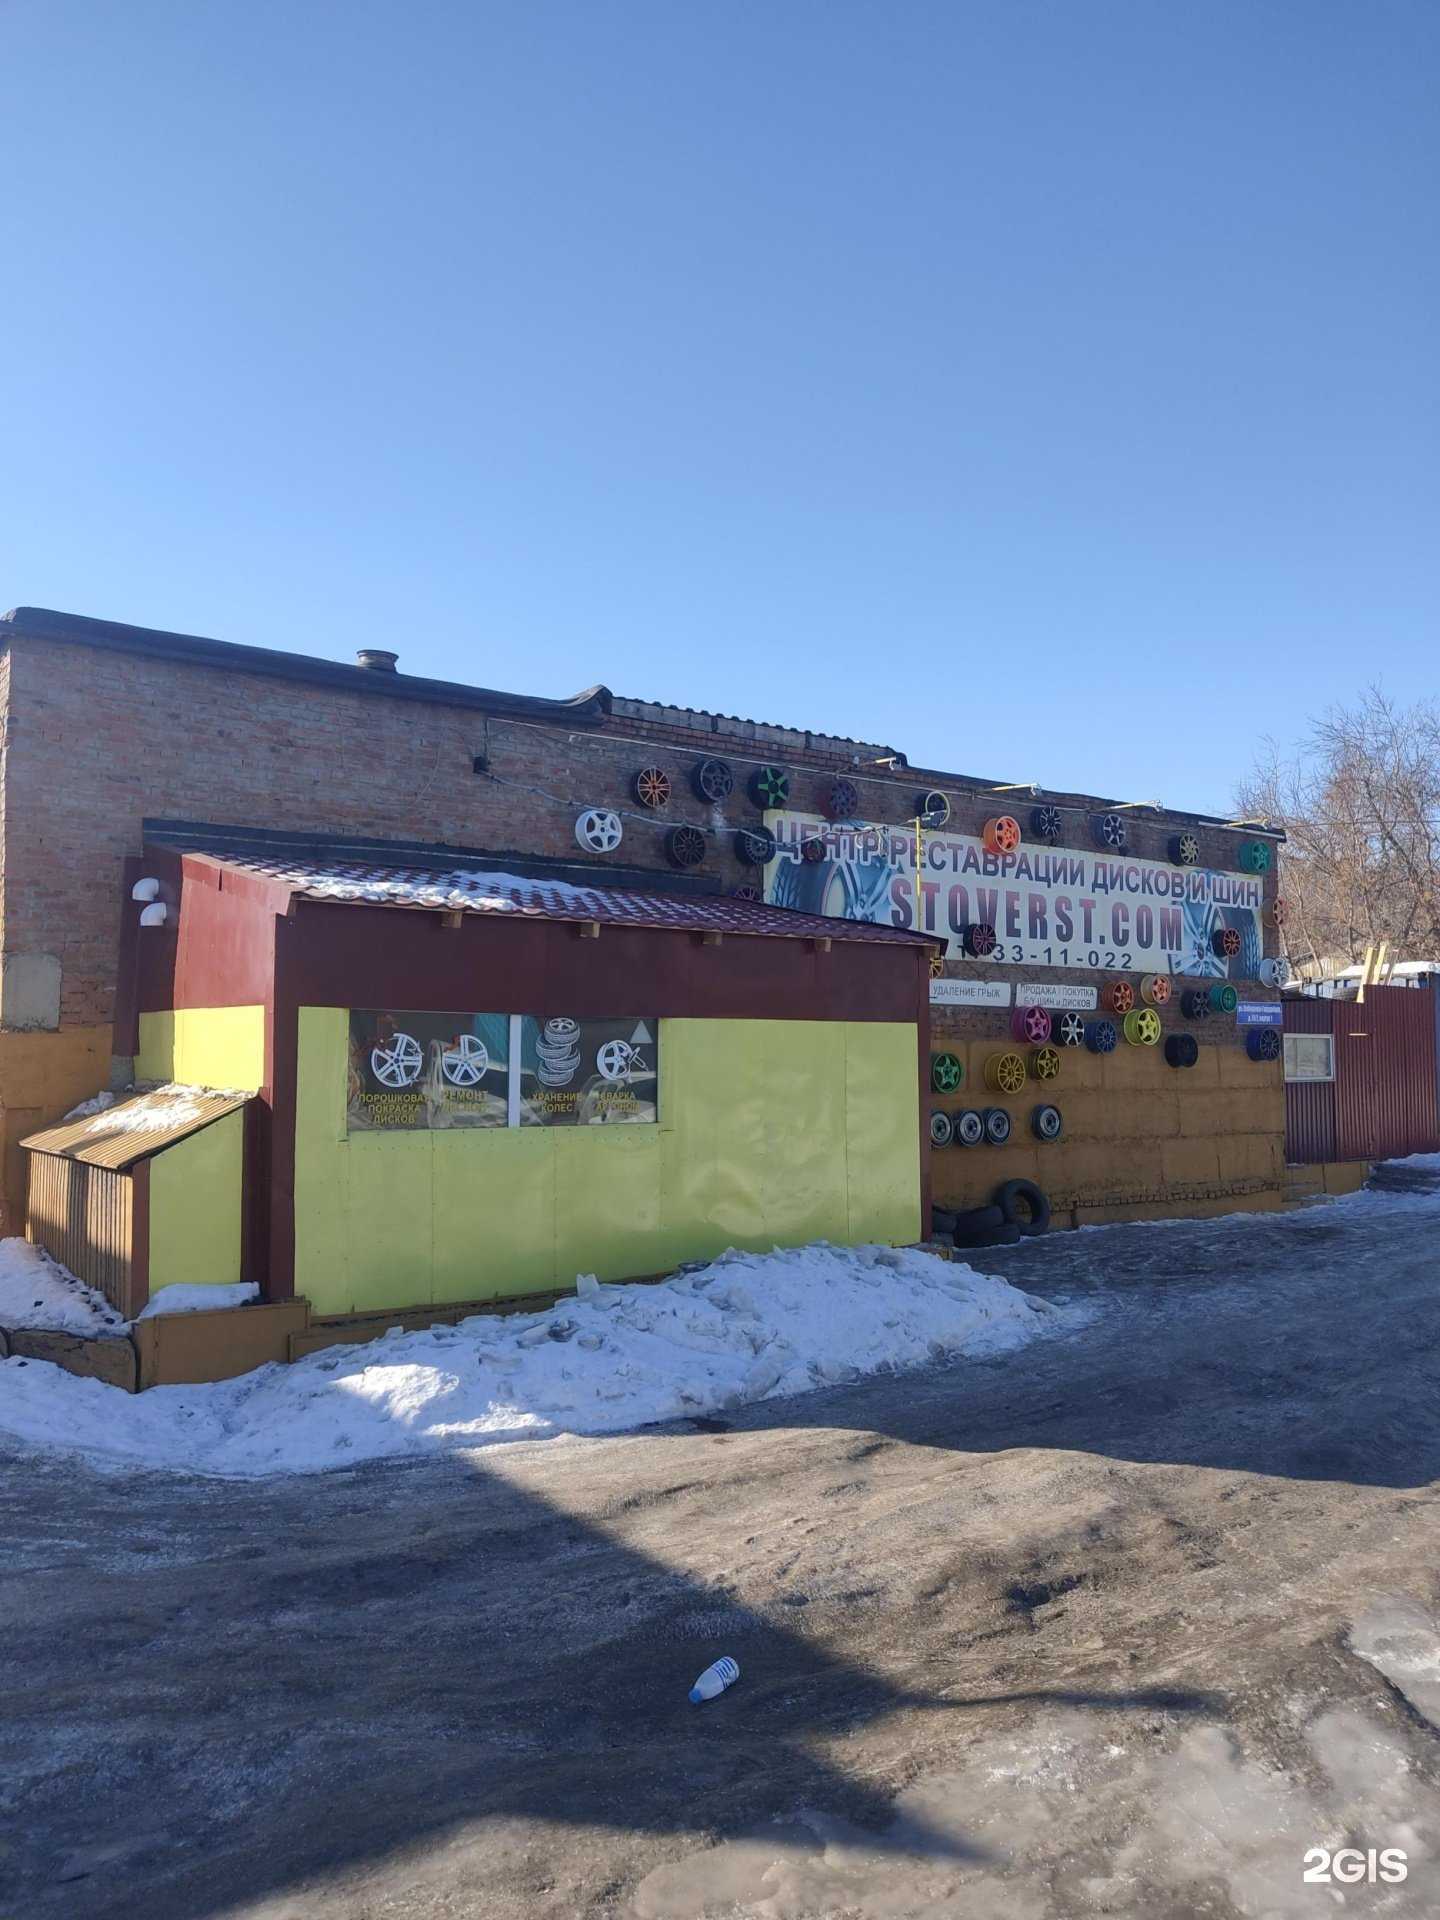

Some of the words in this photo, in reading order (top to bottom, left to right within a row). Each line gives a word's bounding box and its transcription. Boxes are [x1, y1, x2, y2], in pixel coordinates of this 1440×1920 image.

[890, 835, 1085, 888] РЕСТАВРАЦИИ
[1091, 862, 1185, 898] ДИСКОВ
[1190, 873, 1206, 900] И
[1212, 876, 1259, 907] ШИН
[890, 877, 1183, 952] STOVERST.COM
[992, 943, 1133, 970] 33-11-022
[933, 985, 977, 997] УДАЛЕНИЕ
[977, 987, 1001, 998] ГРЫЖ
[1020, 985, 1057, 996] ПРОДАЖА
[1062, 998, 1092, 1009] ДИСКОВ
[368, 1104, 421, 1114] ПОКРАСКА
[374, 1114, 416, 1124] ДИСКОВ
